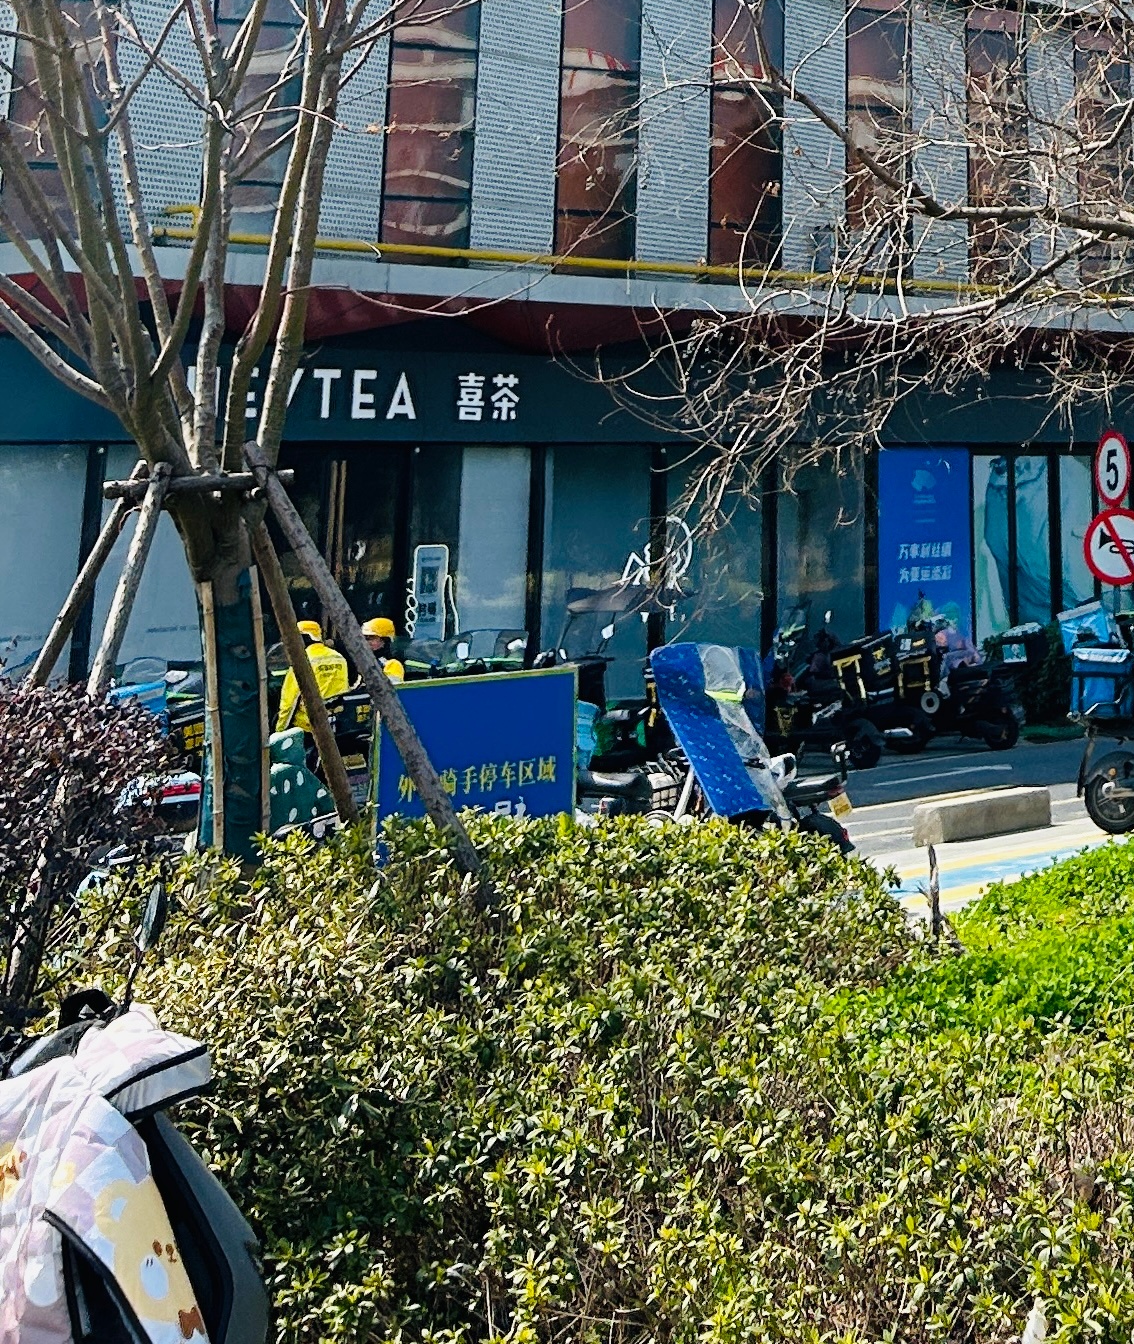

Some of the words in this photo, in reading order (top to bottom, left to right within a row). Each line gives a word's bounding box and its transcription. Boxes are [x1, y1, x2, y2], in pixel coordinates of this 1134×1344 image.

[456, 372, 520, 421] 喜茶
[1105, 448, 1119, 492] 5
[397, 755, 557, 804] 外骑手停车区域
